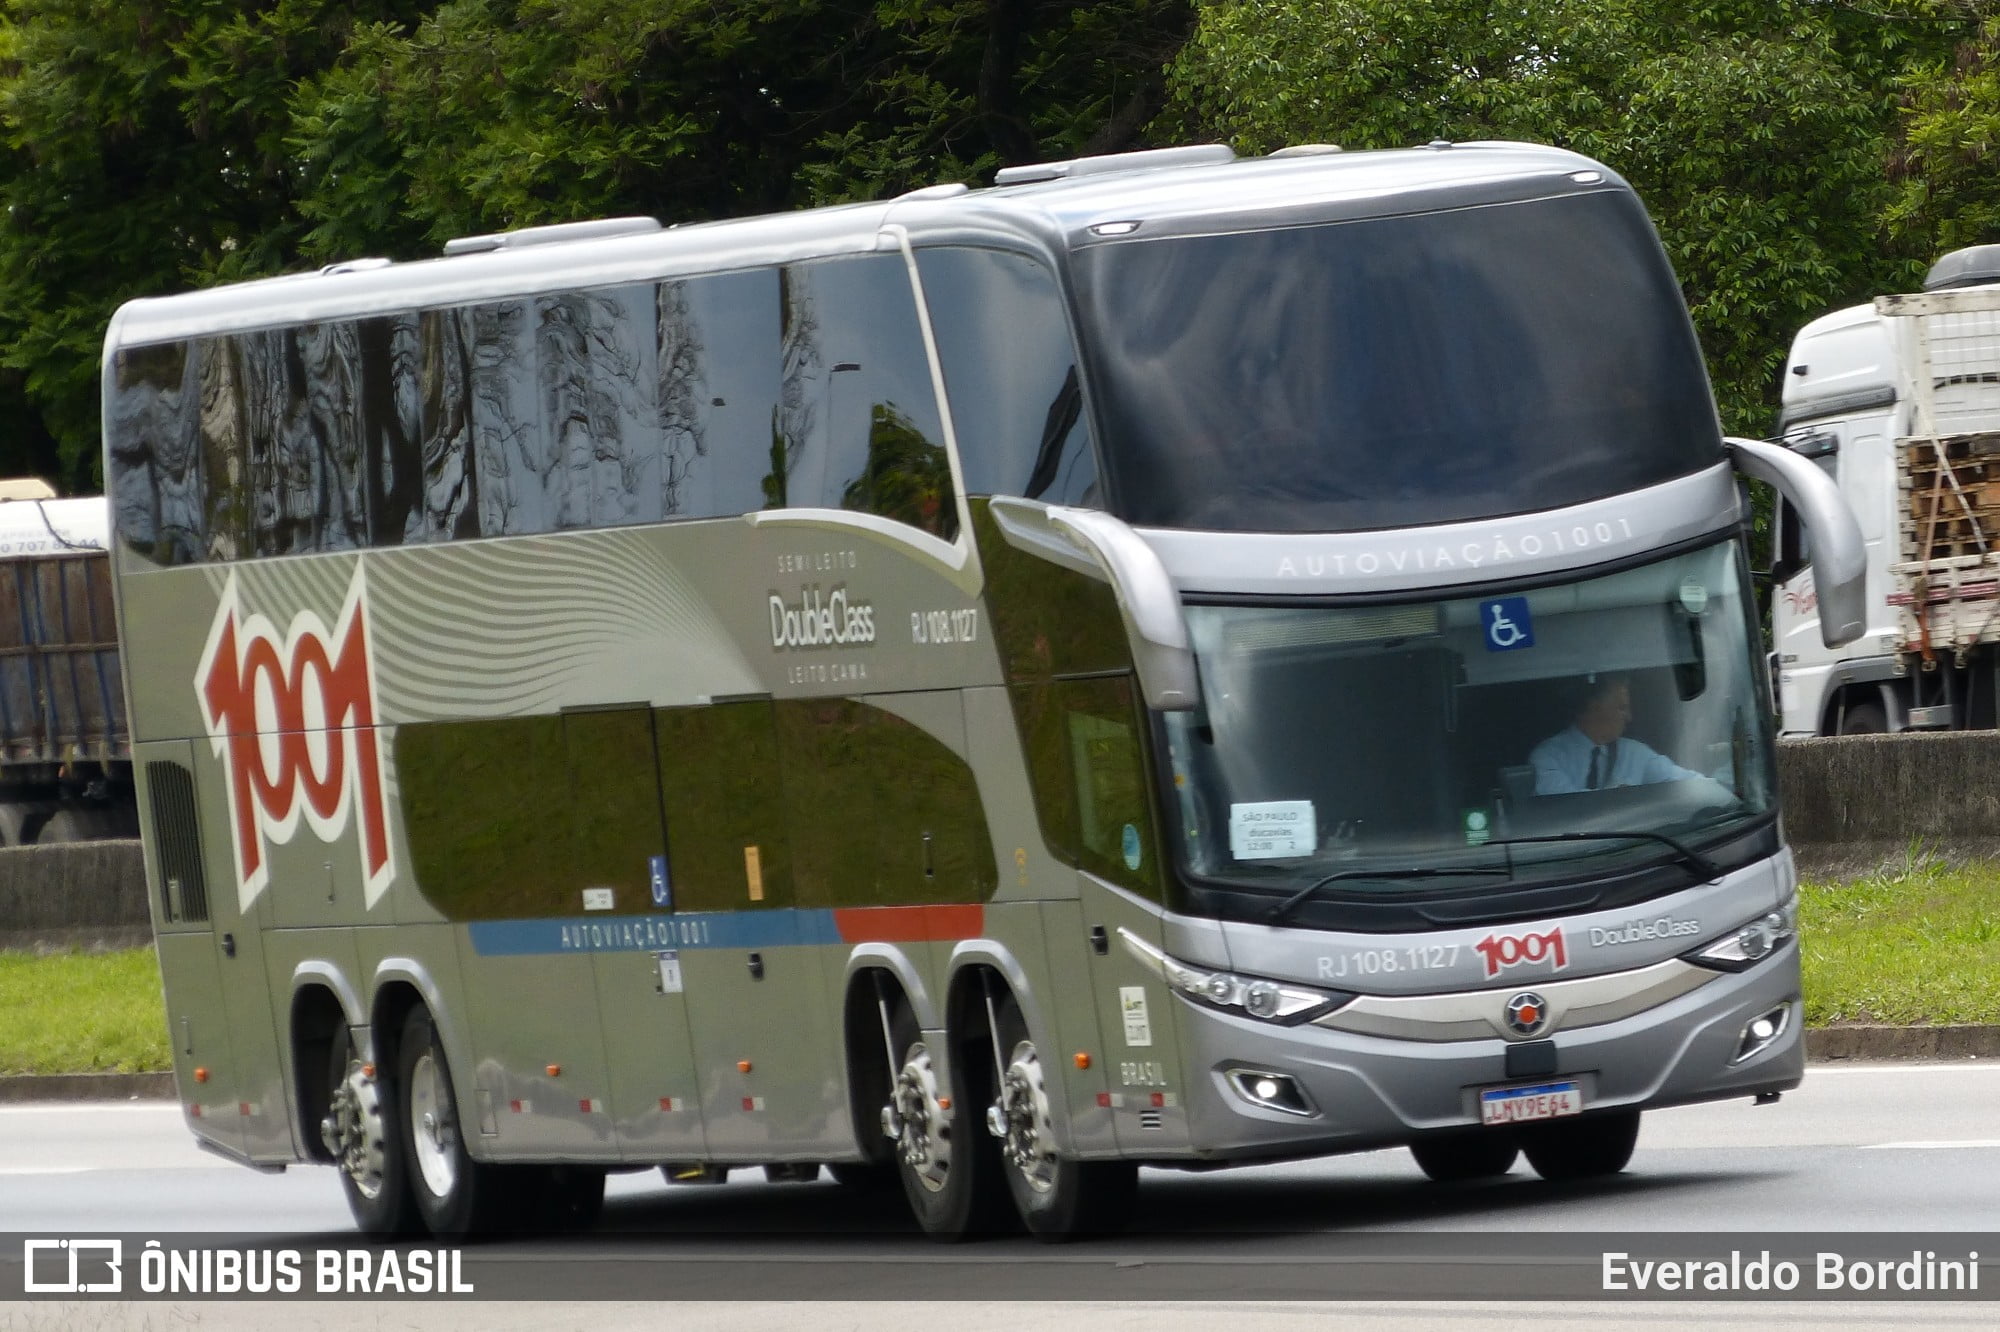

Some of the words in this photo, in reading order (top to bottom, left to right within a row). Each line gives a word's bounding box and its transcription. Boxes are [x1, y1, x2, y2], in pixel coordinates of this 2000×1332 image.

[815, 550, 857, 570] LEITO
[769, 586, 875, 647] DoubleClass
[198, 575, 392, 902] 1001
[1475, 925, 1567, 978] 1001
[1588, 915, 1701, 948] DoubleClass
